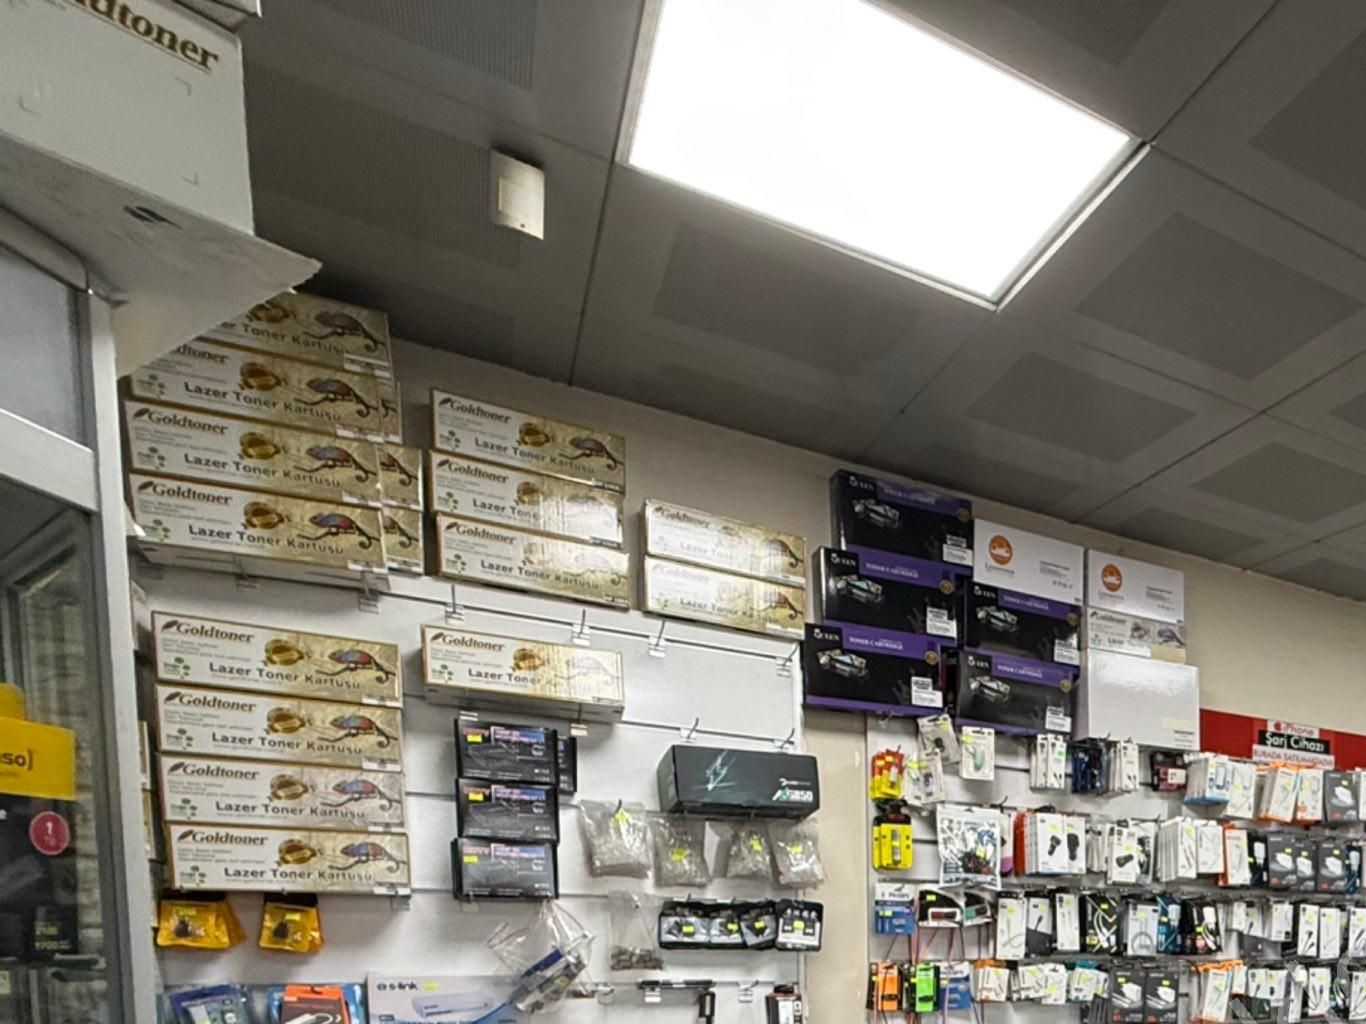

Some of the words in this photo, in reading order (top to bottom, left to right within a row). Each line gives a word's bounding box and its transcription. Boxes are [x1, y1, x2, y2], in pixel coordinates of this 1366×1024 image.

[76, 0, 218, 71] dtoner
[177, 344, 229, 365] dtoner
[184, 381, 228, 399] Lazer
[232, 391, 278, 410] Toner
[450, 398, 512, 424] Goldtoner
[148, 410, 229, 435] Goldtoner
[474, 437, 509, 453] Lazer
[511, 446, 547, 464] Toner
[184, 453, 228, 468] Lazer
[232, 461, 277, 478] Toner
[448, 461, 510, 484] Goldtoner
[151, 482, 233, 506] Goldtoner
[472, 498, 507, 513] Lazer
[188, 523, 233, 538] Lazer
[236, 530, 281, 547] Toner
[454, 522, 517, 545] Goldtoner
[480, 559, 514, 574] Lazer
[516, 566, 551, 581] Toner
[176, 622, 255, 643] Goldtoner
[442, 633, 505, 653] Goldtoner
[209, 661, 252, 677] Lazer
[255, 668, 300, 683] Toner
[467, 667, 503, 681] Lazer
[178, 693, 257, 712] Goldtoner
[212, 732, 254, 746] Lazer
[258, 736, 302, 750] Toner
[1265, 731, 1288, 749] Şarj
[182, 763, 260, 781] Goldtoner
[215, 801, 258, 814] Lazer
[261, 803, 304, 817] Toner
[191, 830, 268, 846] Goldtoner
[224, 867, 267, 880] Lazer
[269, 868, 312, 881] Toner
